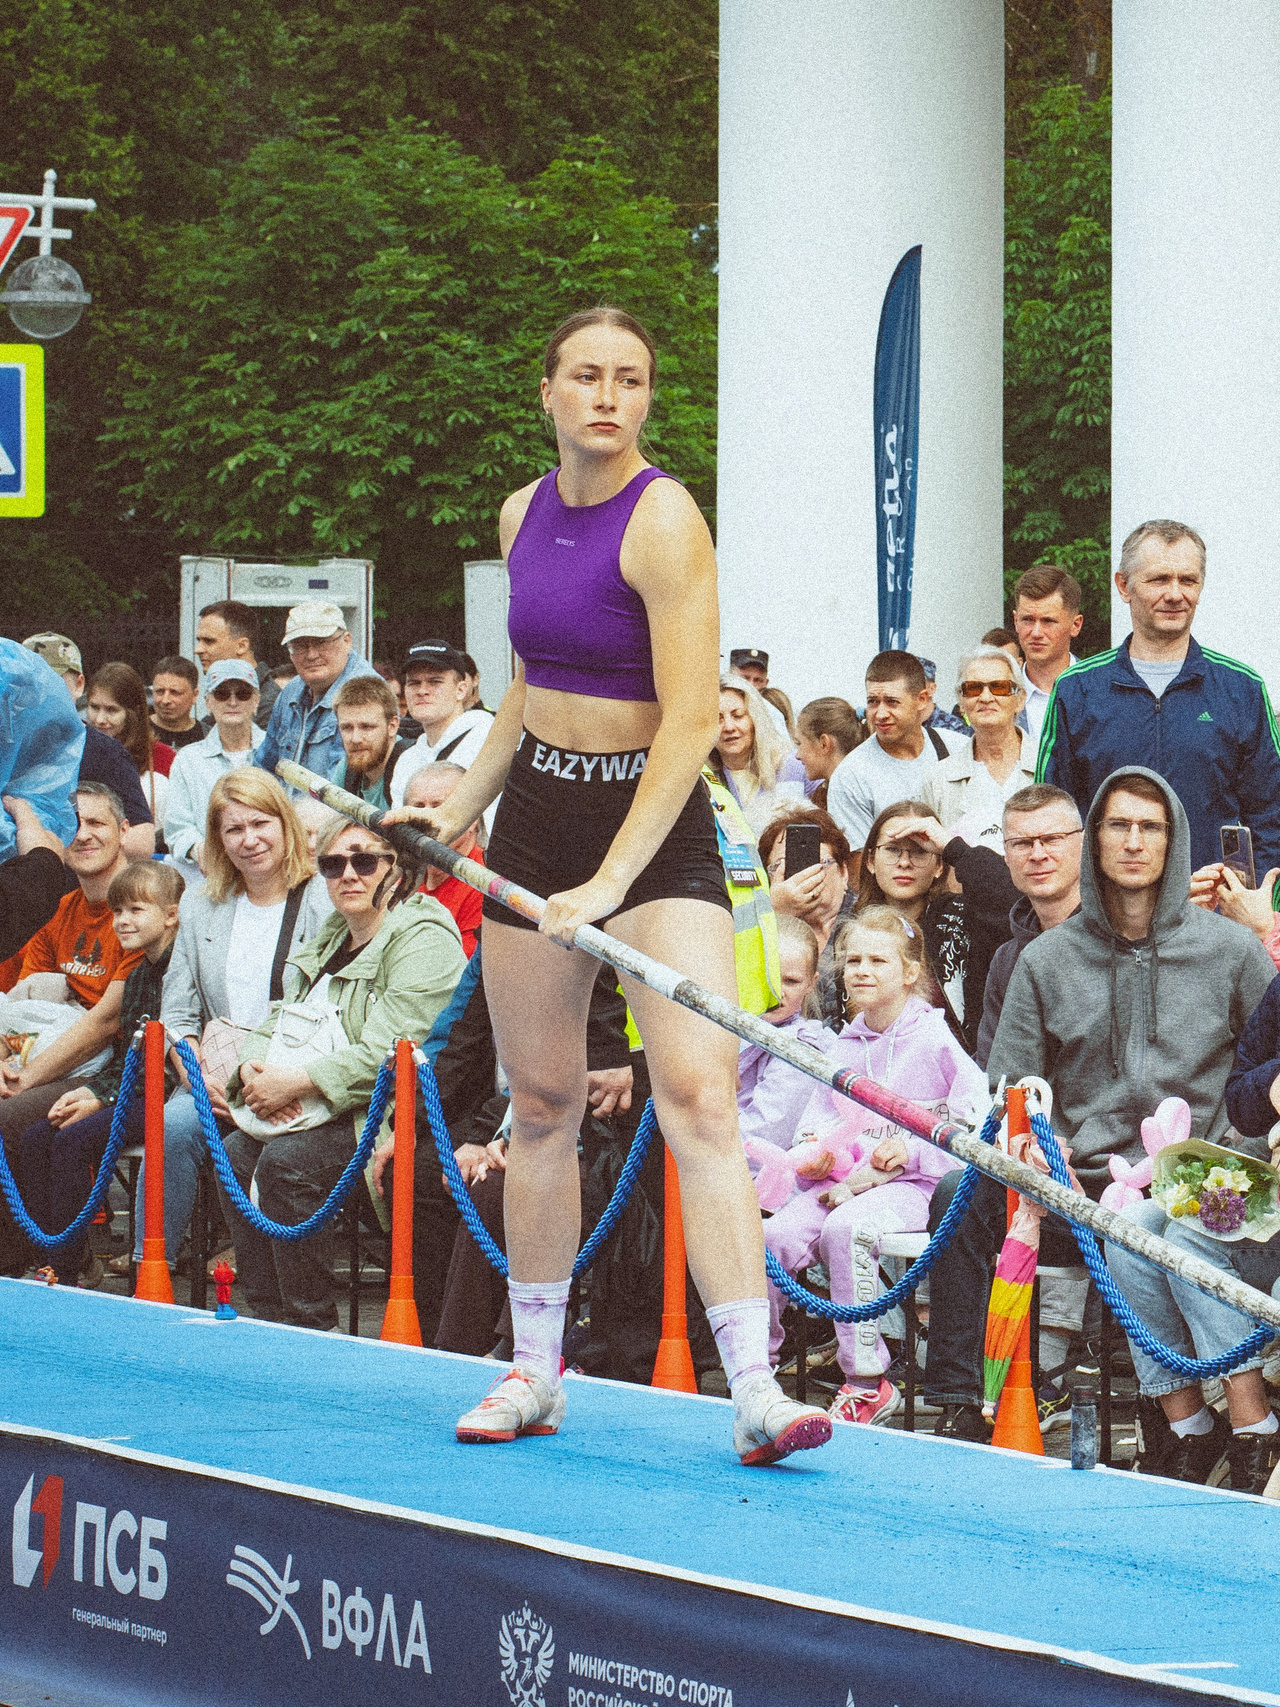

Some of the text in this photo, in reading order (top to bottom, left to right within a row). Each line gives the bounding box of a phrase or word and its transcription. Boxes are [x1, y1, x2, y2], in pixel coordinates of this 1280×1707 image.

[73, 1501, 168, 1600] ПСБ
[72, 1607, 168, 1647] генеральный партнер
[321, 1579, 433, 1674] ВФЛА
[568, 1651, 734, 1707] МИНИСТЕРСТВО СПОРТА
